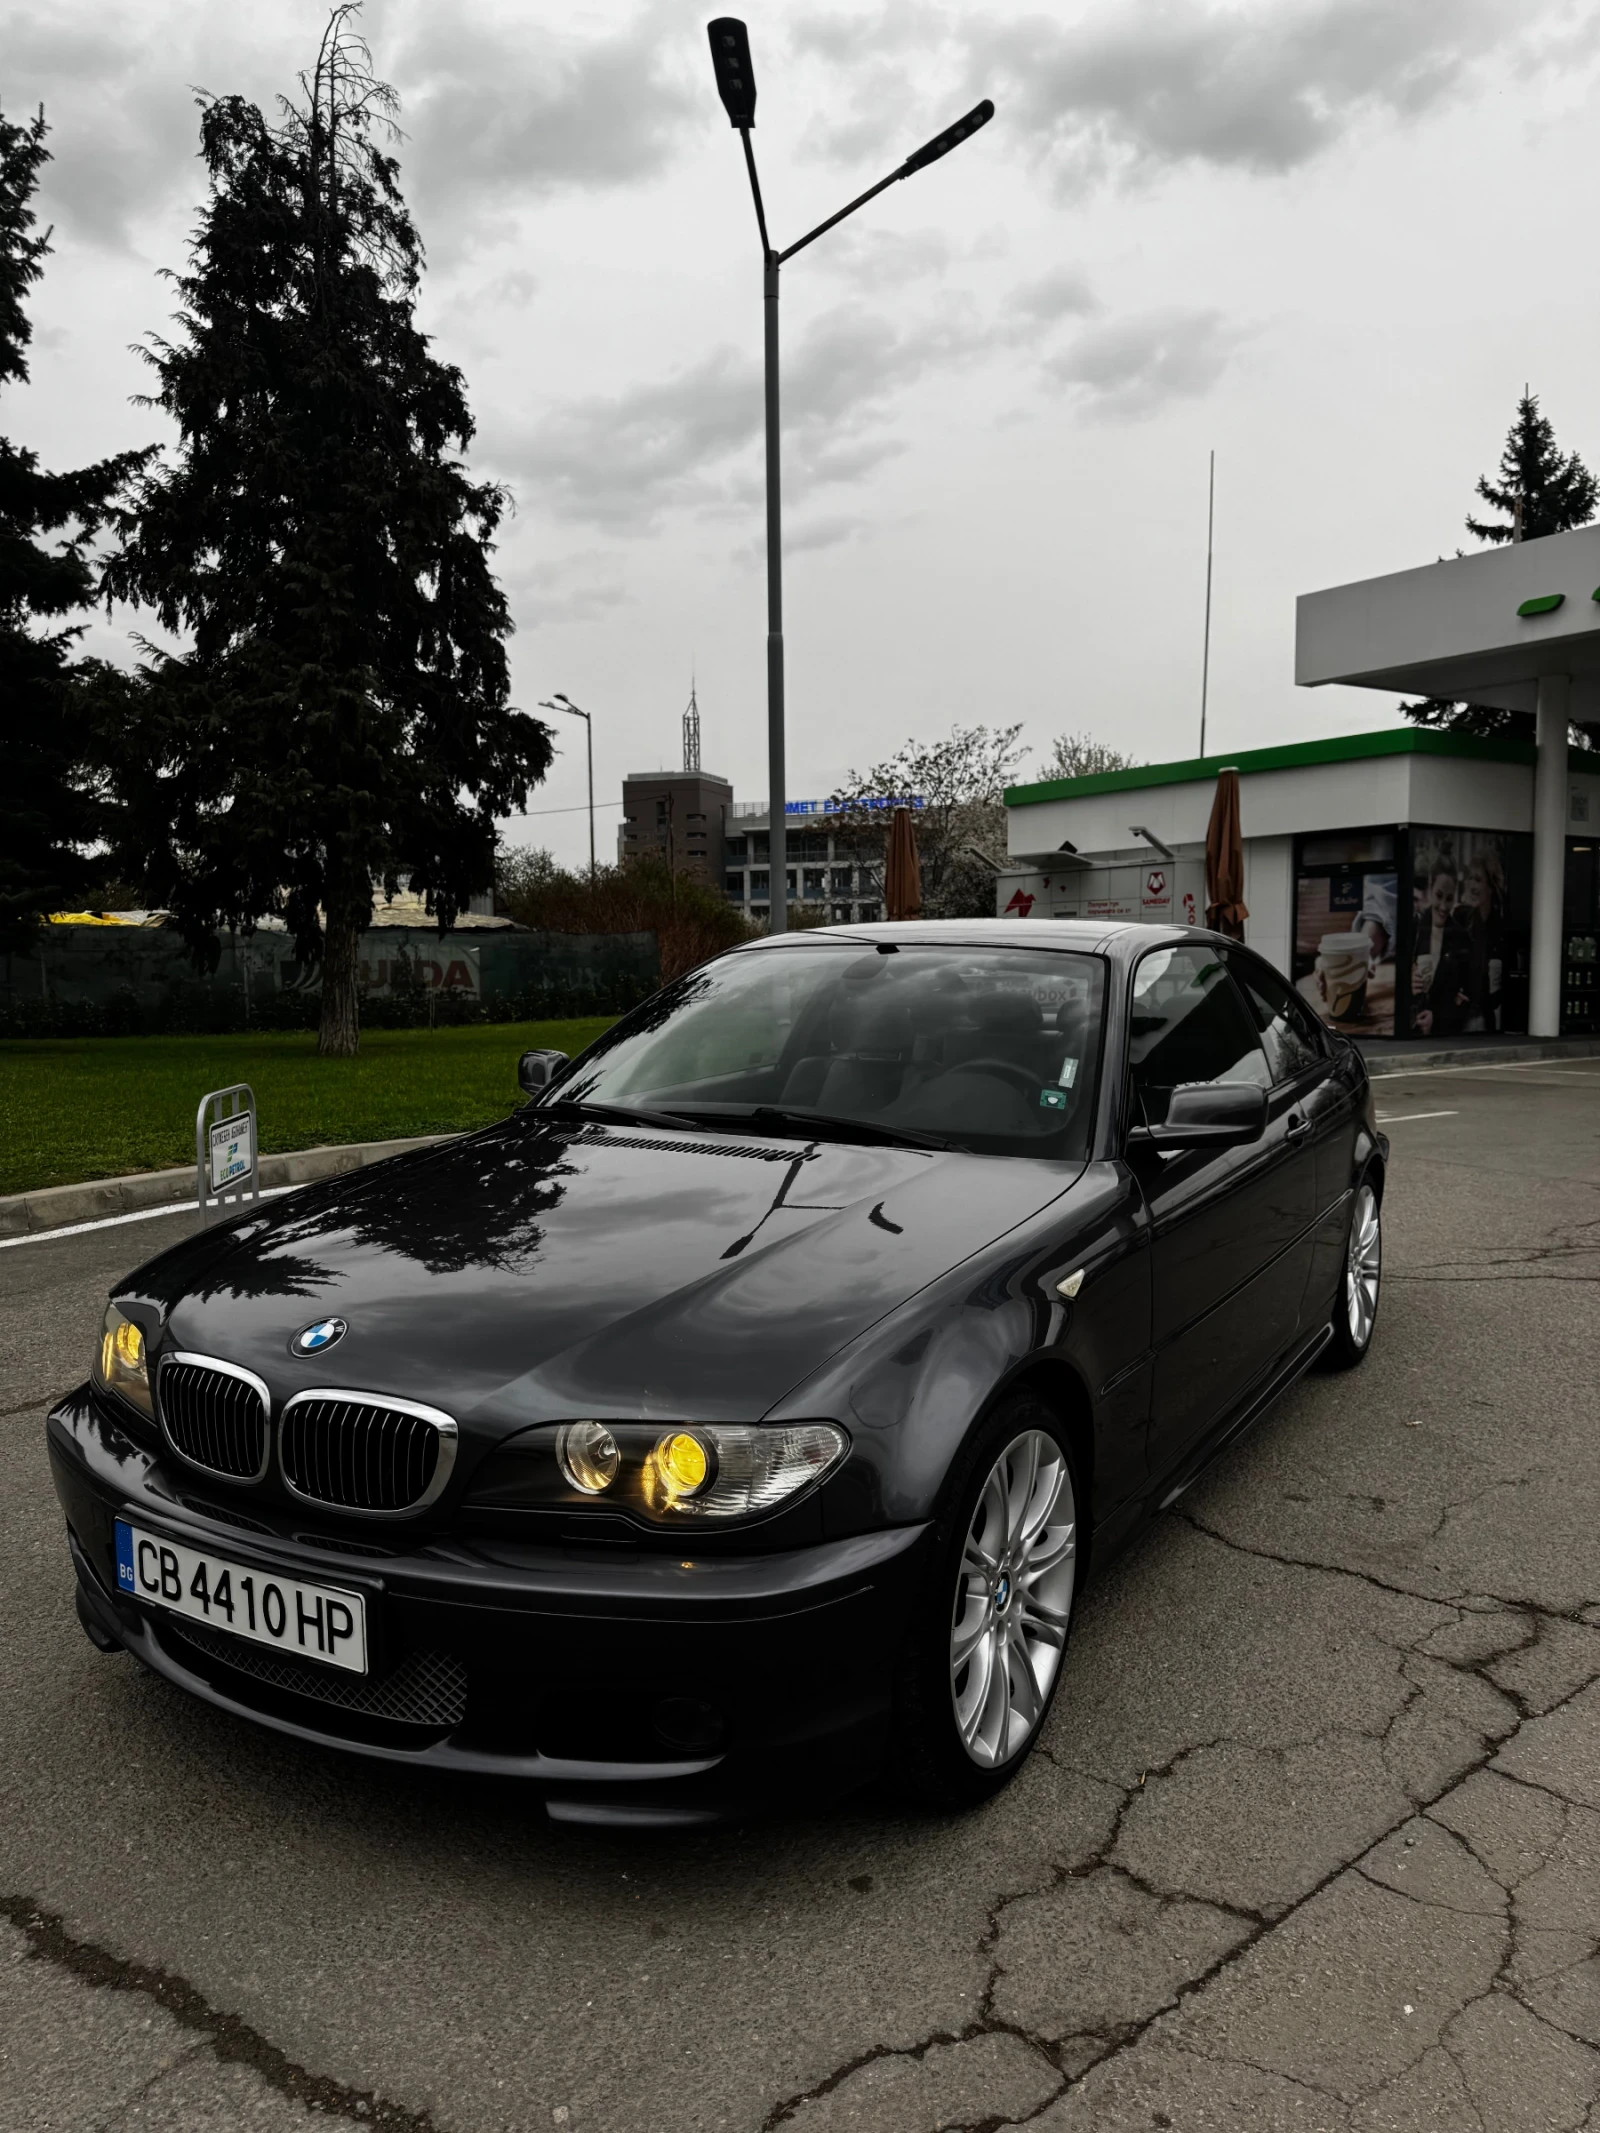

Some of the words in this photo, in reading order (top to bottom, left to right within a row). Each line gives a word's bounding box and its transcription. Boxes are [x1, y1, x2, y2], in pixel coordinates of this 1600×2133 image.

[785, 801, 816, 814] OMET
[220, 1159, 245, 1181] ECOPETROL
[120, 1562, 133, 1581] BG
[138, 1539, 182, 1601] CB
[190, 1561, 286, 1638] 4410
[296, 1590, 354, 1656] HP
